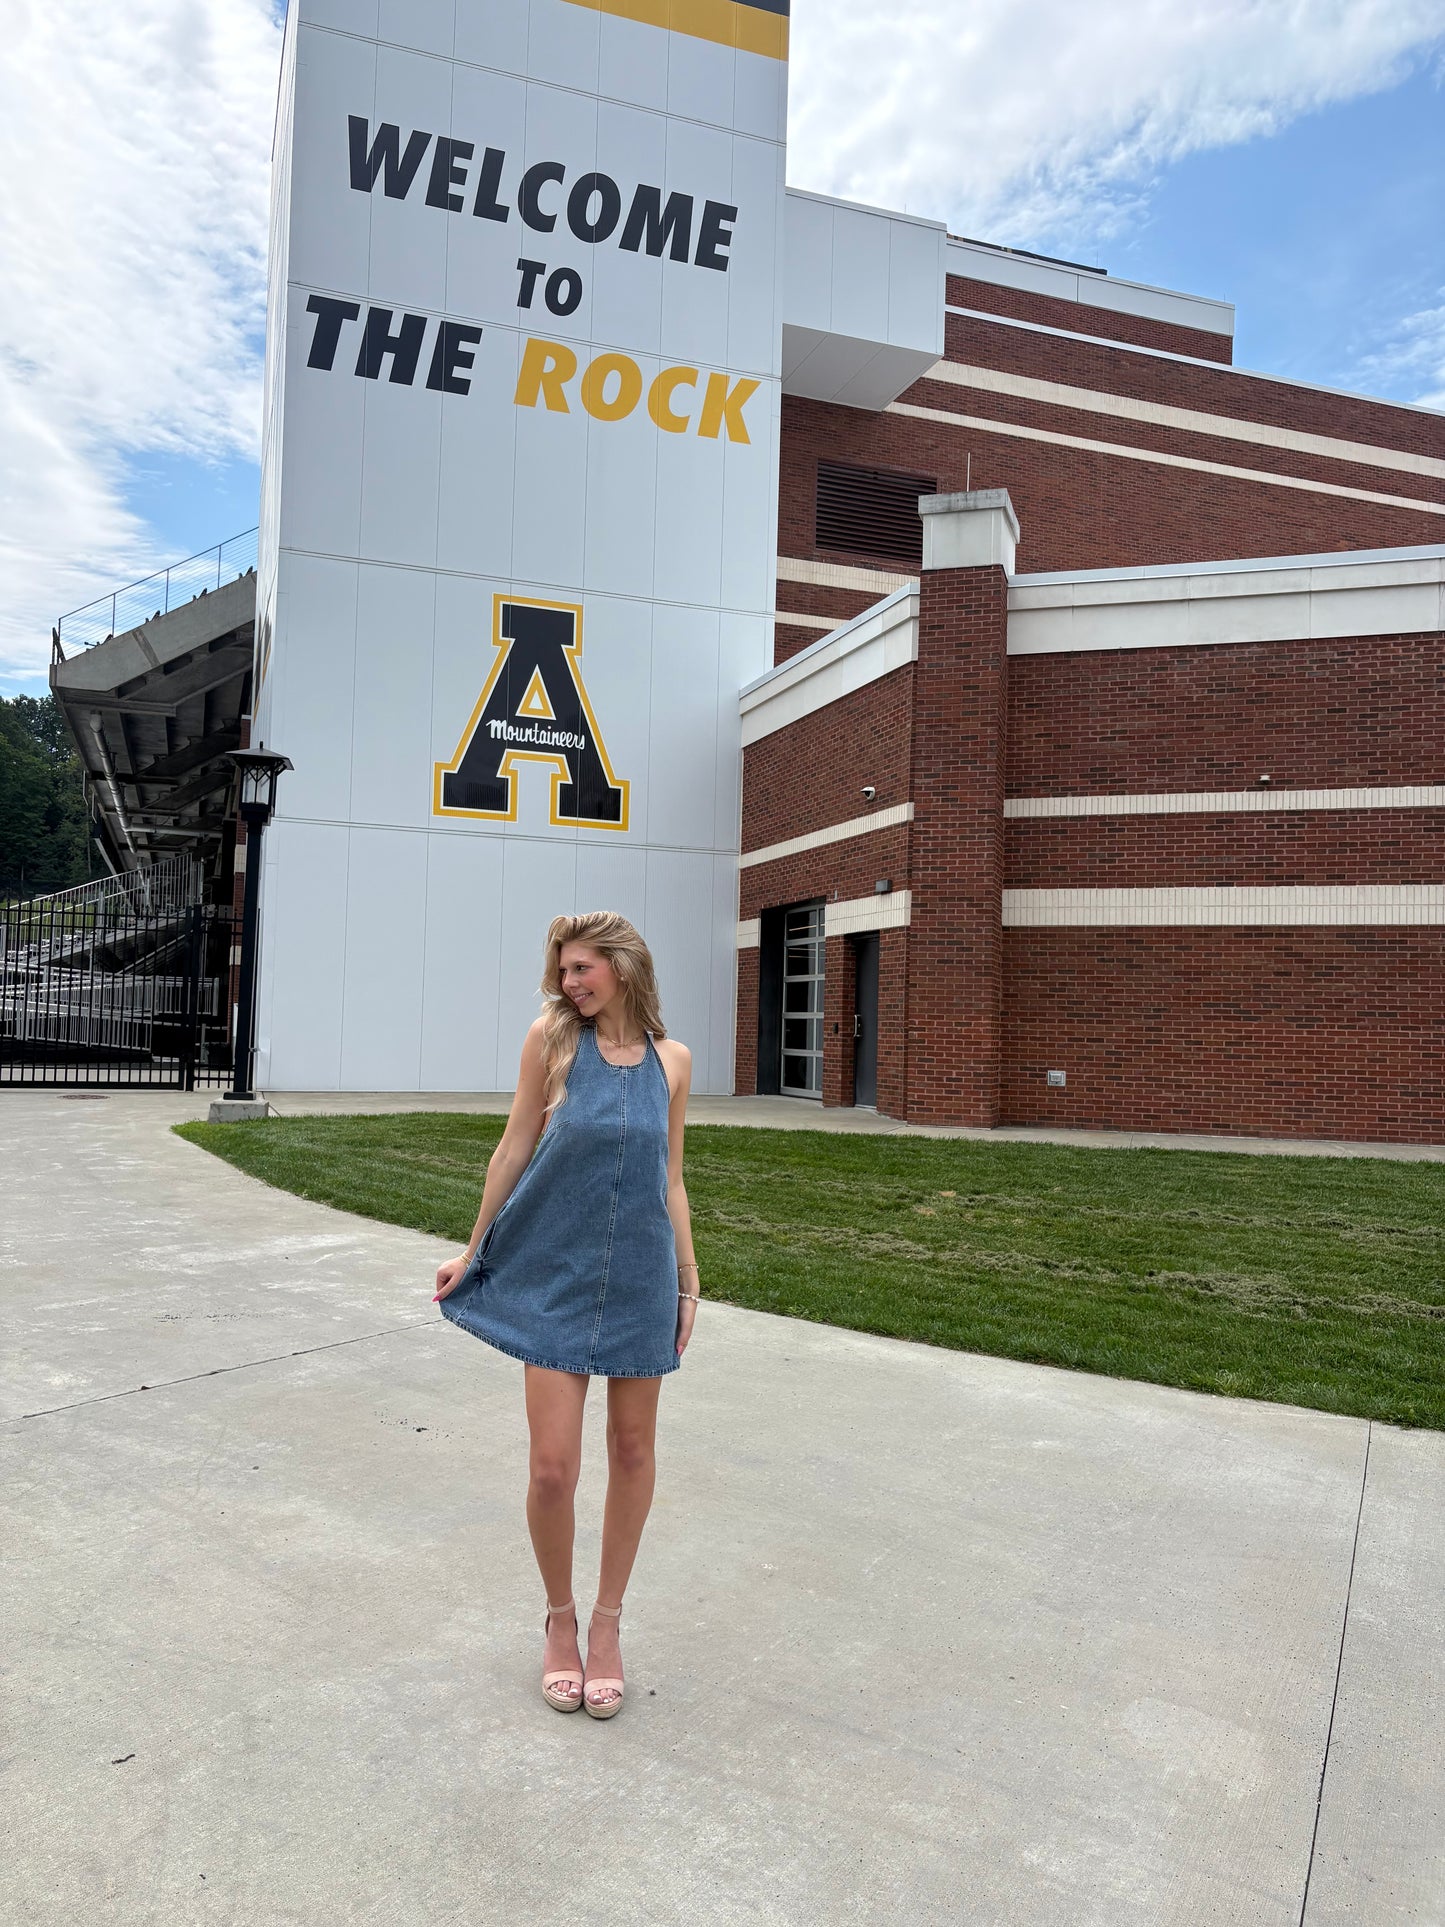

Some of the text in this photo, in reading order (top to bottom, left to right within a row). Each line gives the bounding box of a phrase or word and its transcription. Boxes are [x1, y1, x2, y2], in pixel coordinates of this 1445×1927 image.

[348, 115, 738, 272] WELCOME
[516, 258, 583, 317] TO
[306, 294, 762, 444] THE ROCK
[432, 593, 631, 832] A
[486, 719, 585, 750] Mountaineers
